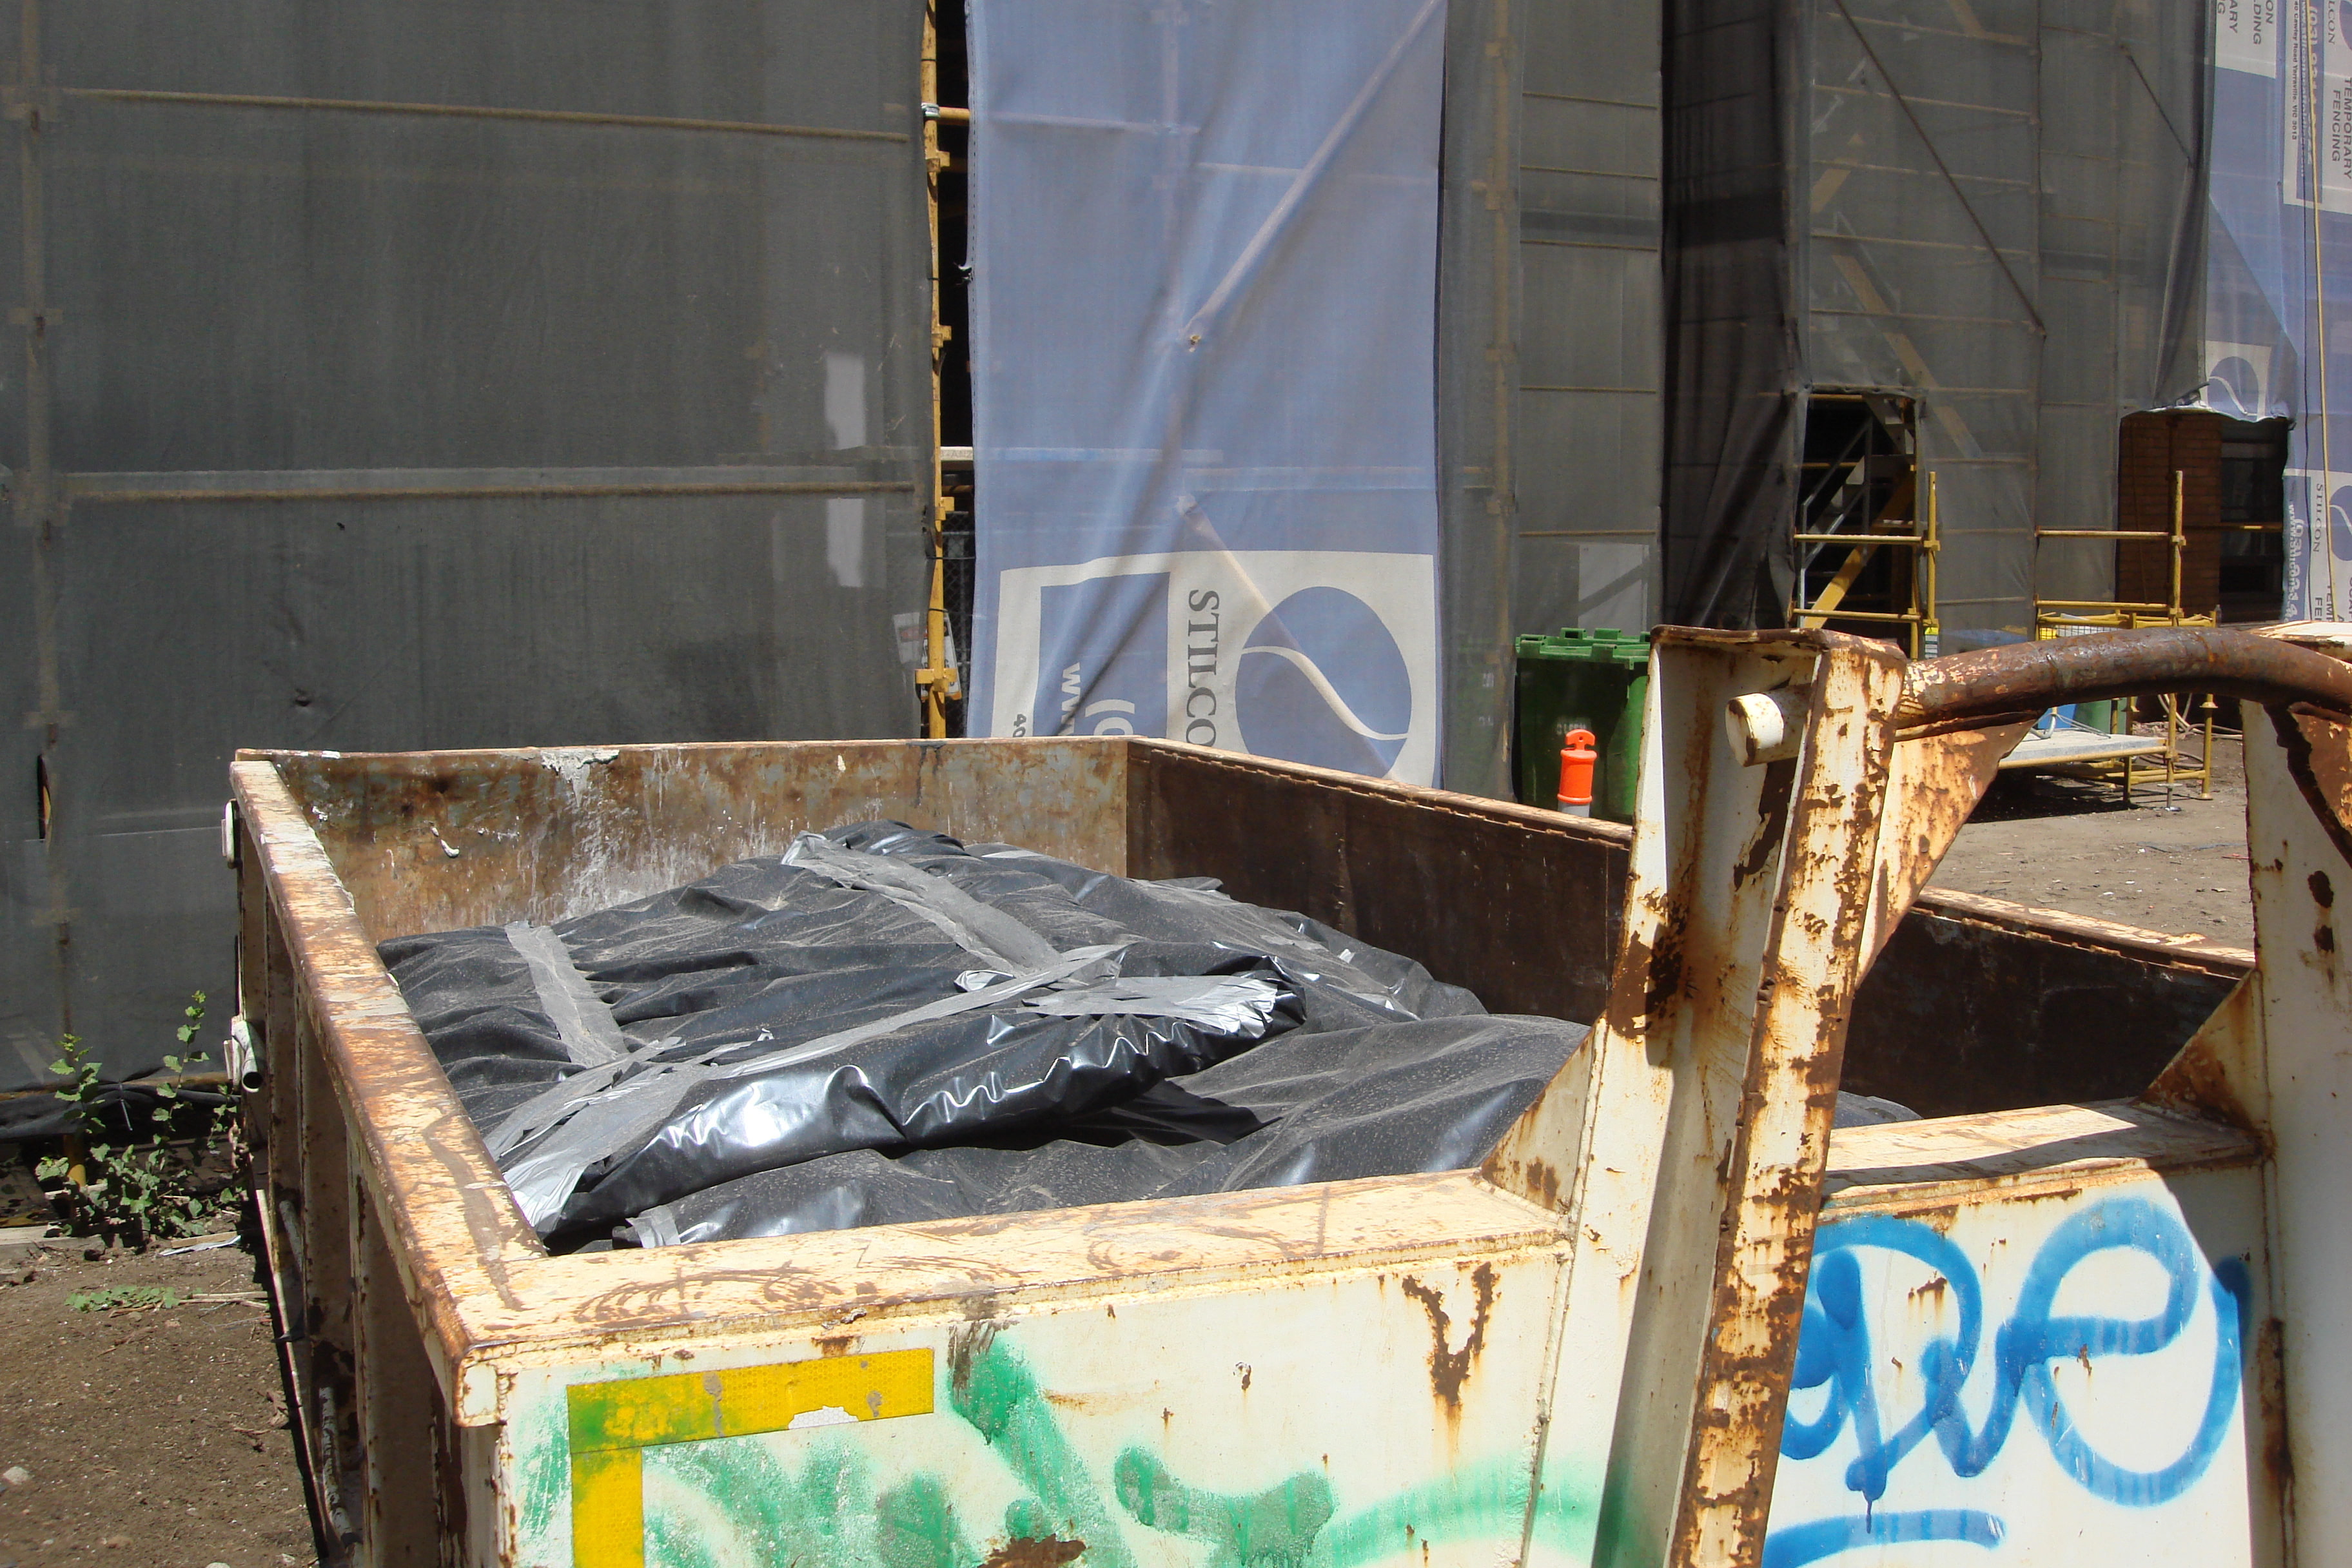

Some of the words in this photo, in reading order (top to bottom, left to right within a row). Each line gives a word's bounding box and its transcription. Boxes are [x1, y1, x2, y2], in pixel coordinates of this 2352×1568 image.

[2332, 90, 2340, 162] FENCING
[2344, 77, 2352, 179] TEMPORARY
[2313, 484, 2323, 552] STILCON
